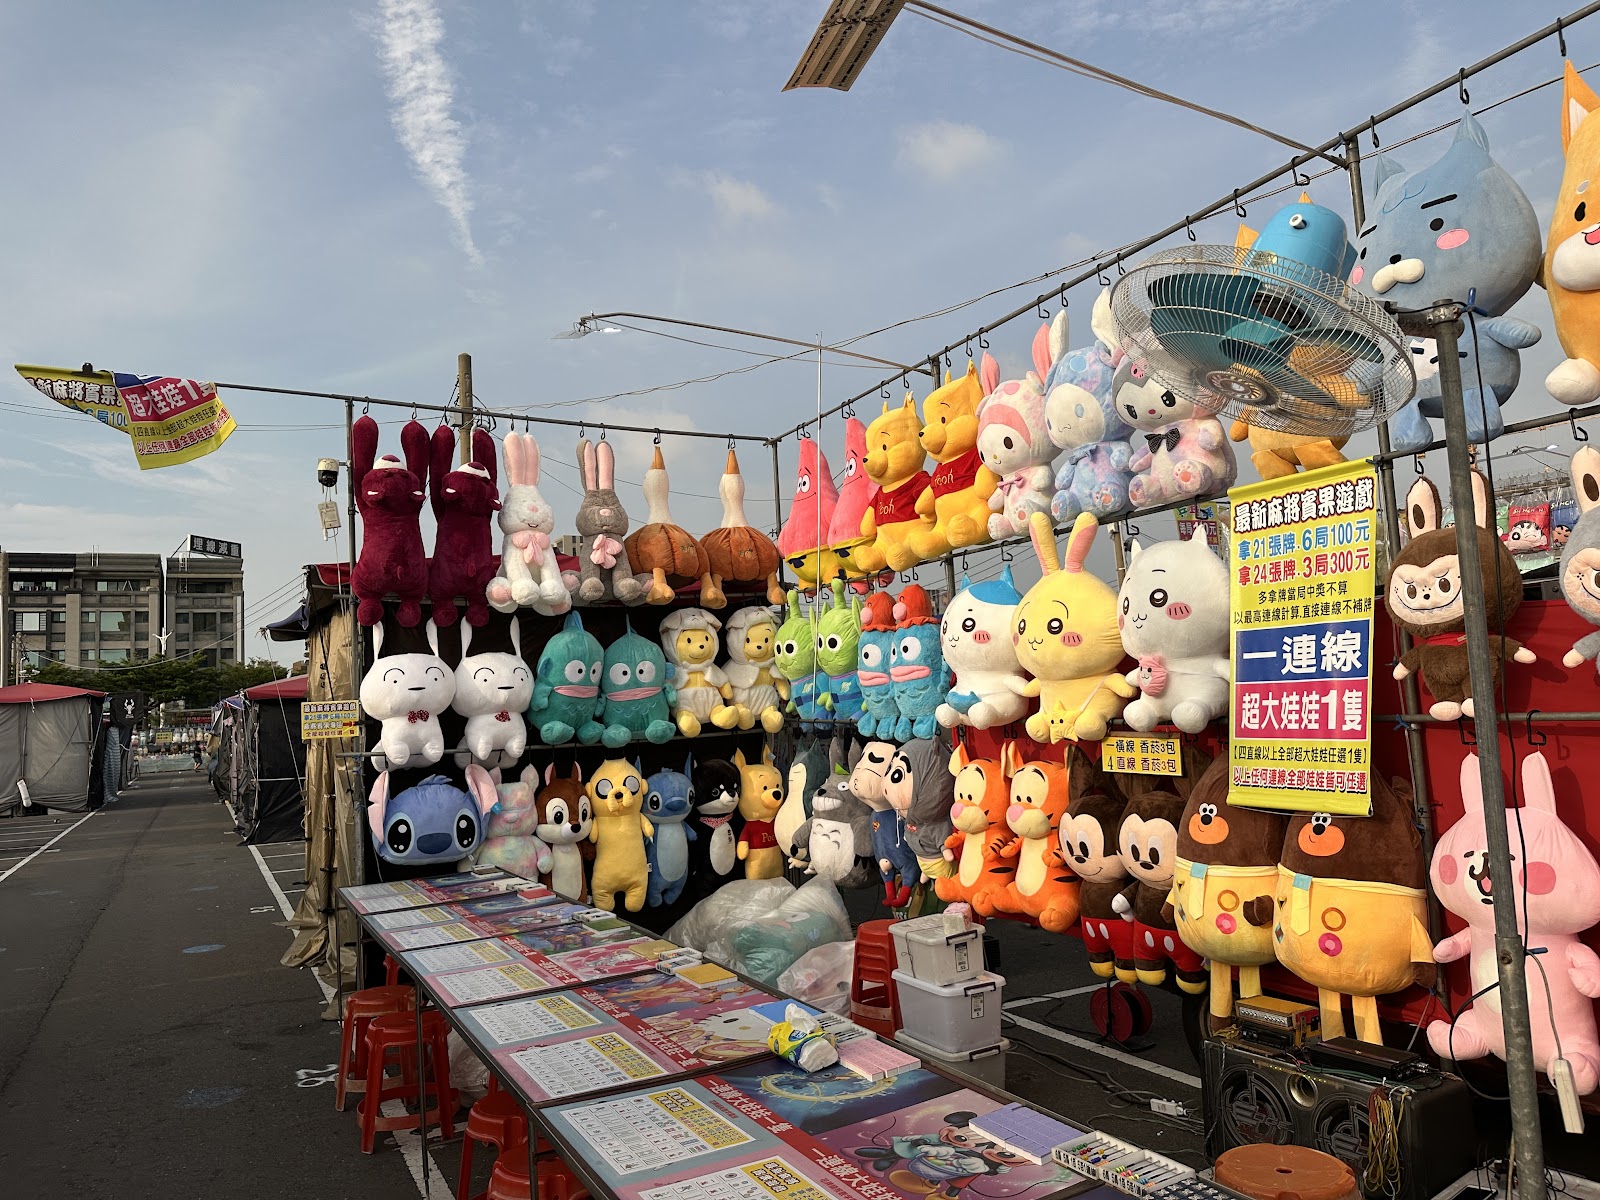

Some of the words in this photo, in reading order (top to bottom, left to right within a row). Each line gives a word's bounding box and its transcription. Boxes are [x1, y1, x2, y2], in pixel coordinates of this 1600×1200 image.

[1234, 478, 1374, 533] 最新麻將賓果遊戲
[1258, 581, 1348, 605] 多拿牌當局中獎不算
[1243, 630, 1363, 675] 一連線
[1241, 689, 1363, 731] 超大娃娃1隻
[1140, 740, 1176, 755] 香菸3包
[1141, 758, 1177, 773] 香菸3包
[1233, 767, 1368, 794] 以上任何連線全部娃娃皆可任選
[762, 833, 776, 842] Poo
[708, 1079, 794, 1134] 一連線大娃娃一隻
